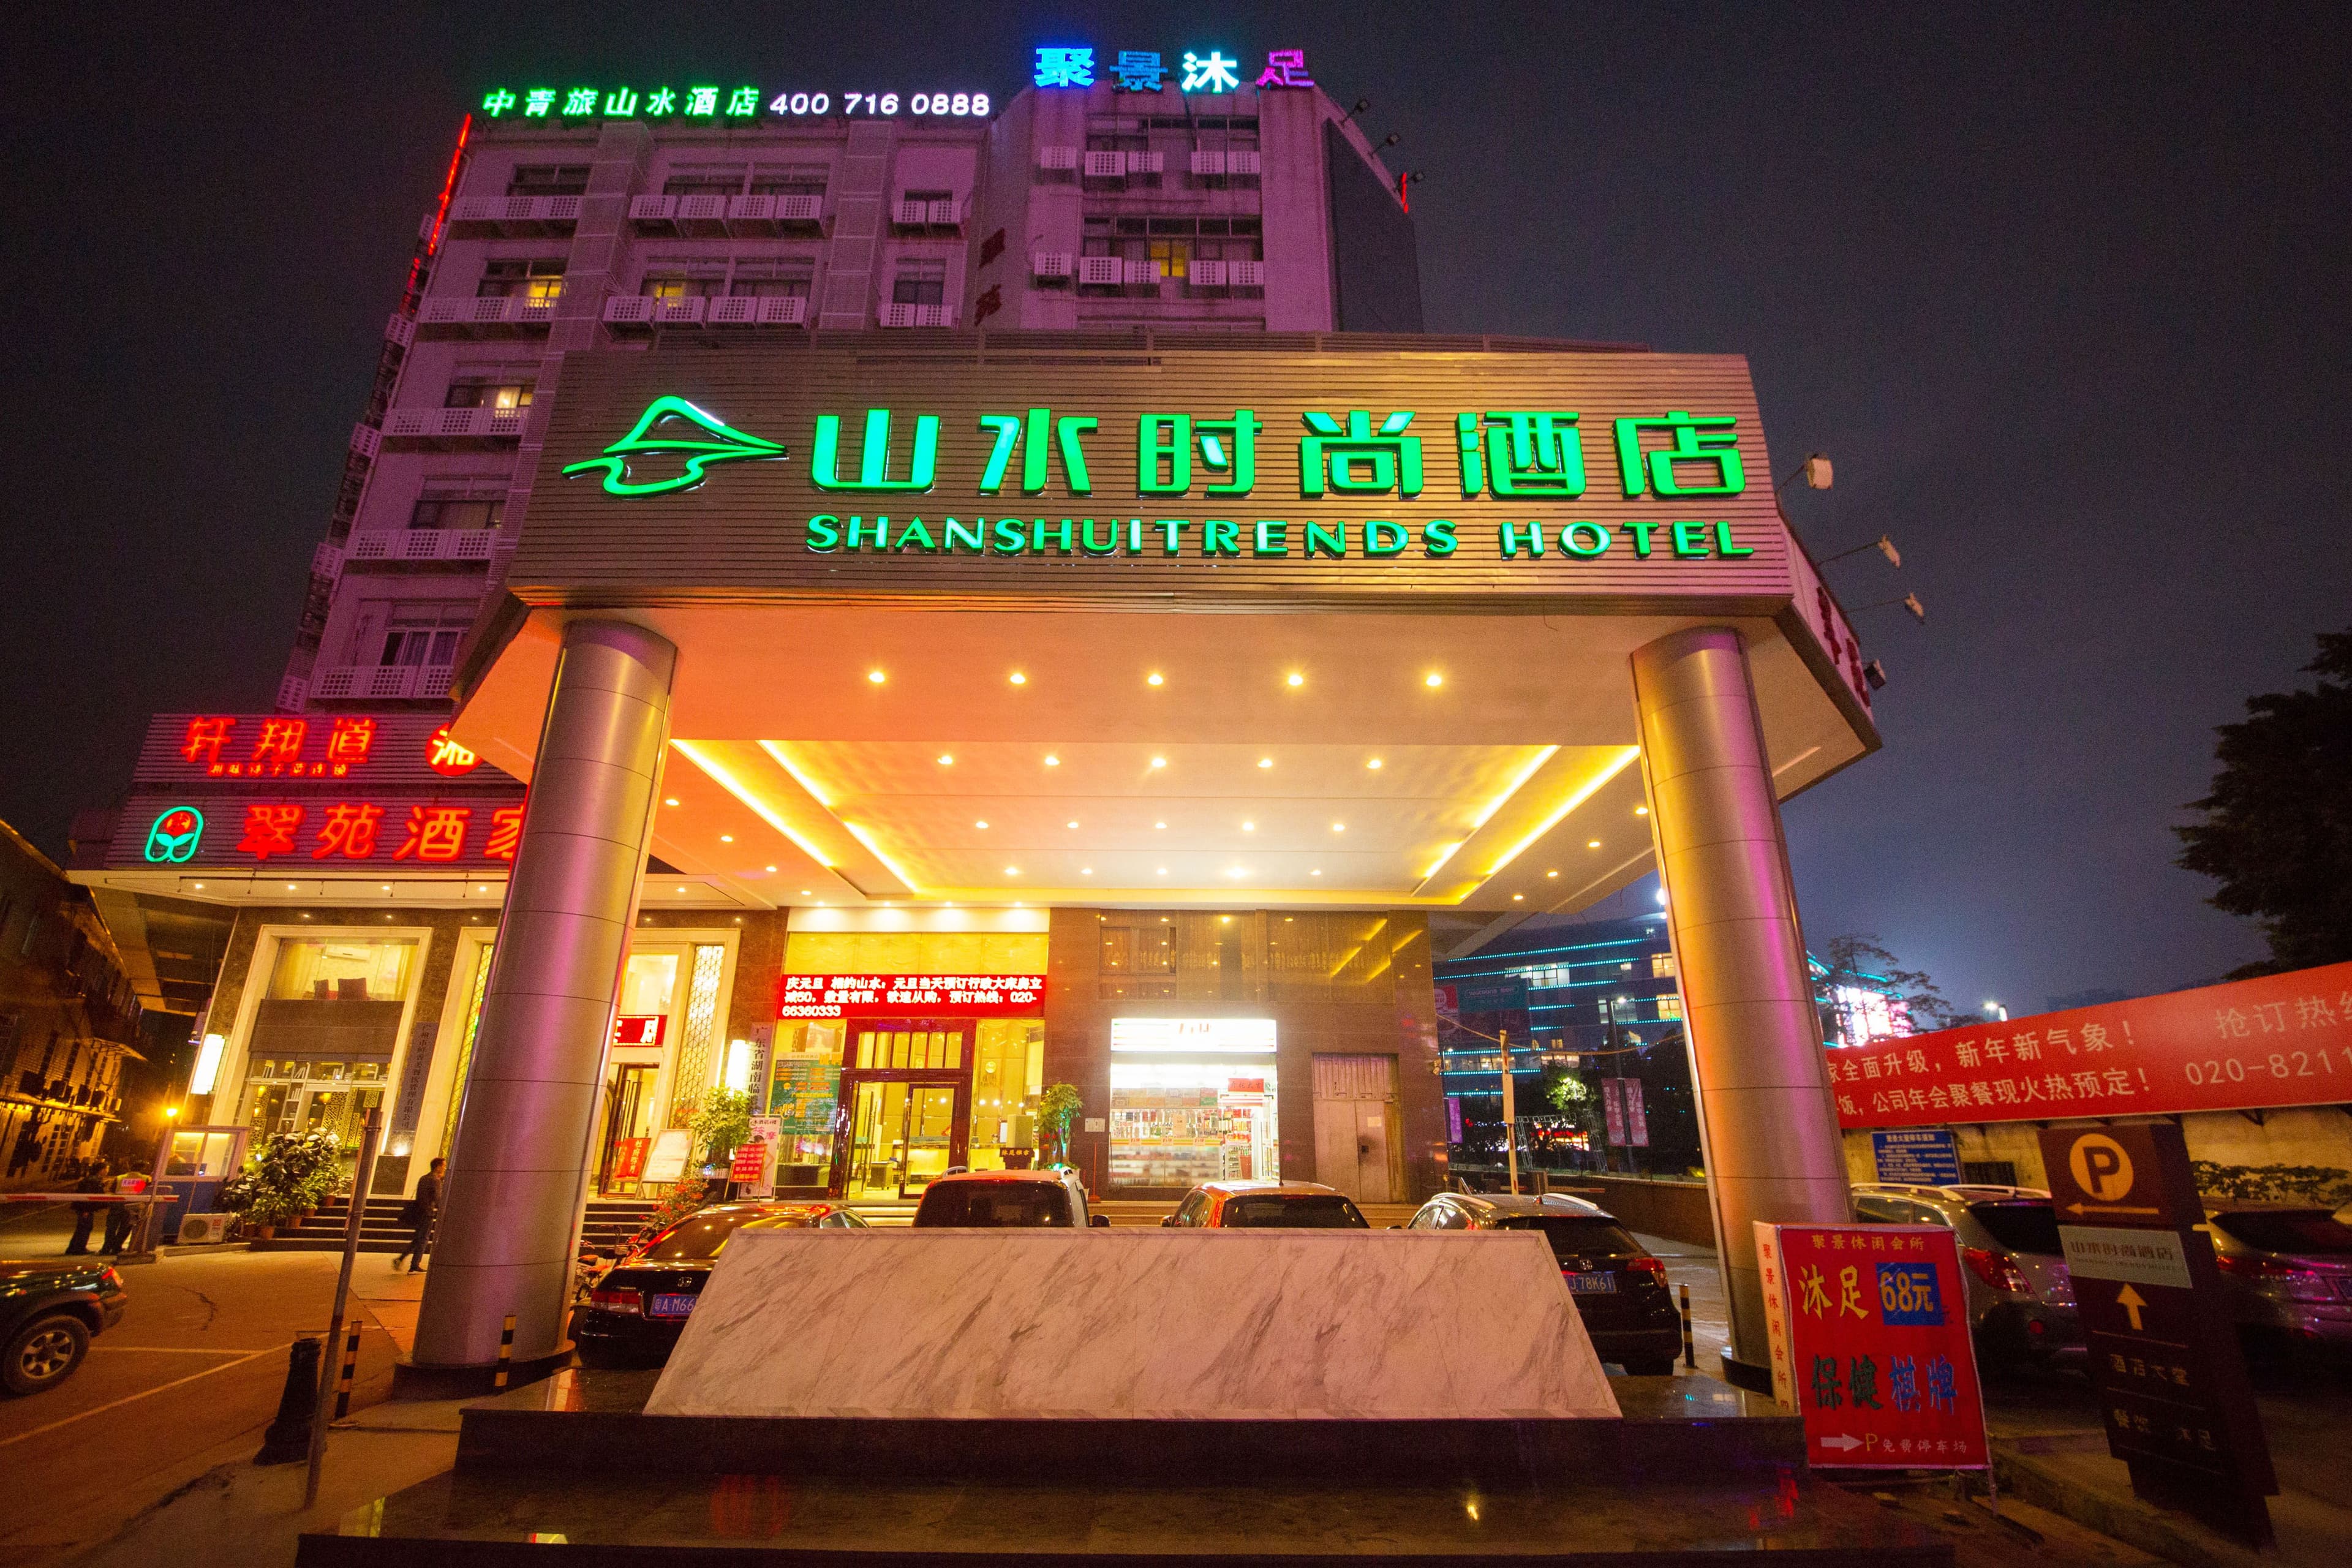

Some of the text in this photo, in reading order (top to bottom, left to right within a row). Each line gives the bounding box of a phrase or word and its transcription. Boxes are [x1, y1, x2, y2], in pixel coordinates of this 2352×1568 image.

[1033, 48, 1315, 94] 聚景沐足
[481, 86, 991, 118] 中青旅山水酒店 400 716 0888
[811, 409, 1748, 495] 山水时尚酒店
[1498, 520, 1754, 560] HOTEL
[1837, 1066, 2151, 1116] 饭，公司年会聚餐现火热预定！
[2082, 1145, 2120, 1194] P
[1811, 1234, 1925, 1252] 聚景休闲会所
[1798, 1264, 1934, 1321] 沐足 68元
